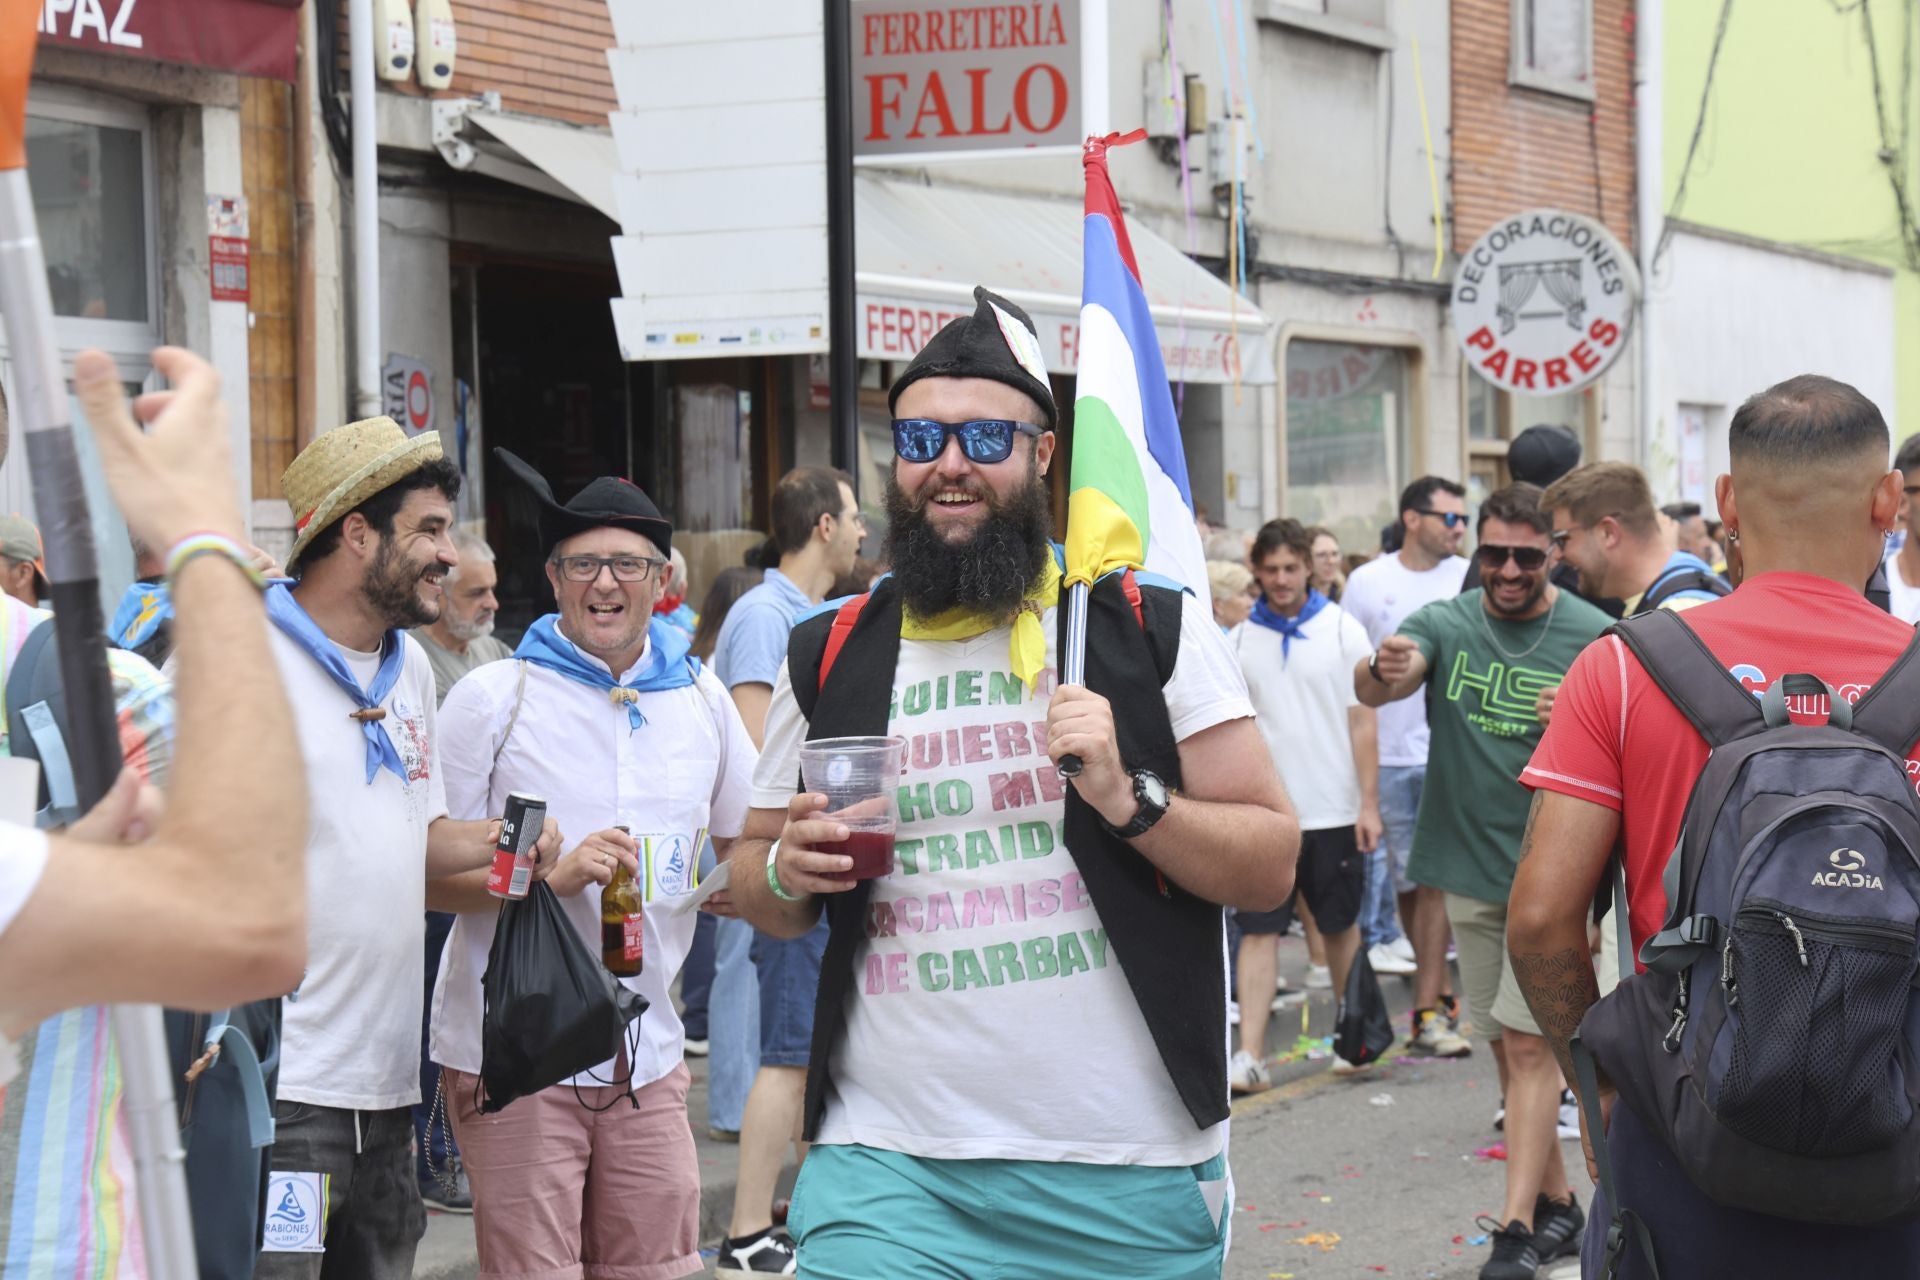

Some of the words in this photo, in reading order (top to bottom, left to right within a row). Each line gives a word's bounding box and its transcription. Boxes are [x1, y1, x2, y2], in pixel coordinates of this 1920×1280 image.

[863, 0, 1067, 57] FERRETERÍA
[863, 63, 1069, 141] FALO
[1457, 216, 1624, 305] DECORACIONES
[1466, 317, 1619, 390] PARRES
[865, 952, 910, 996] DE
